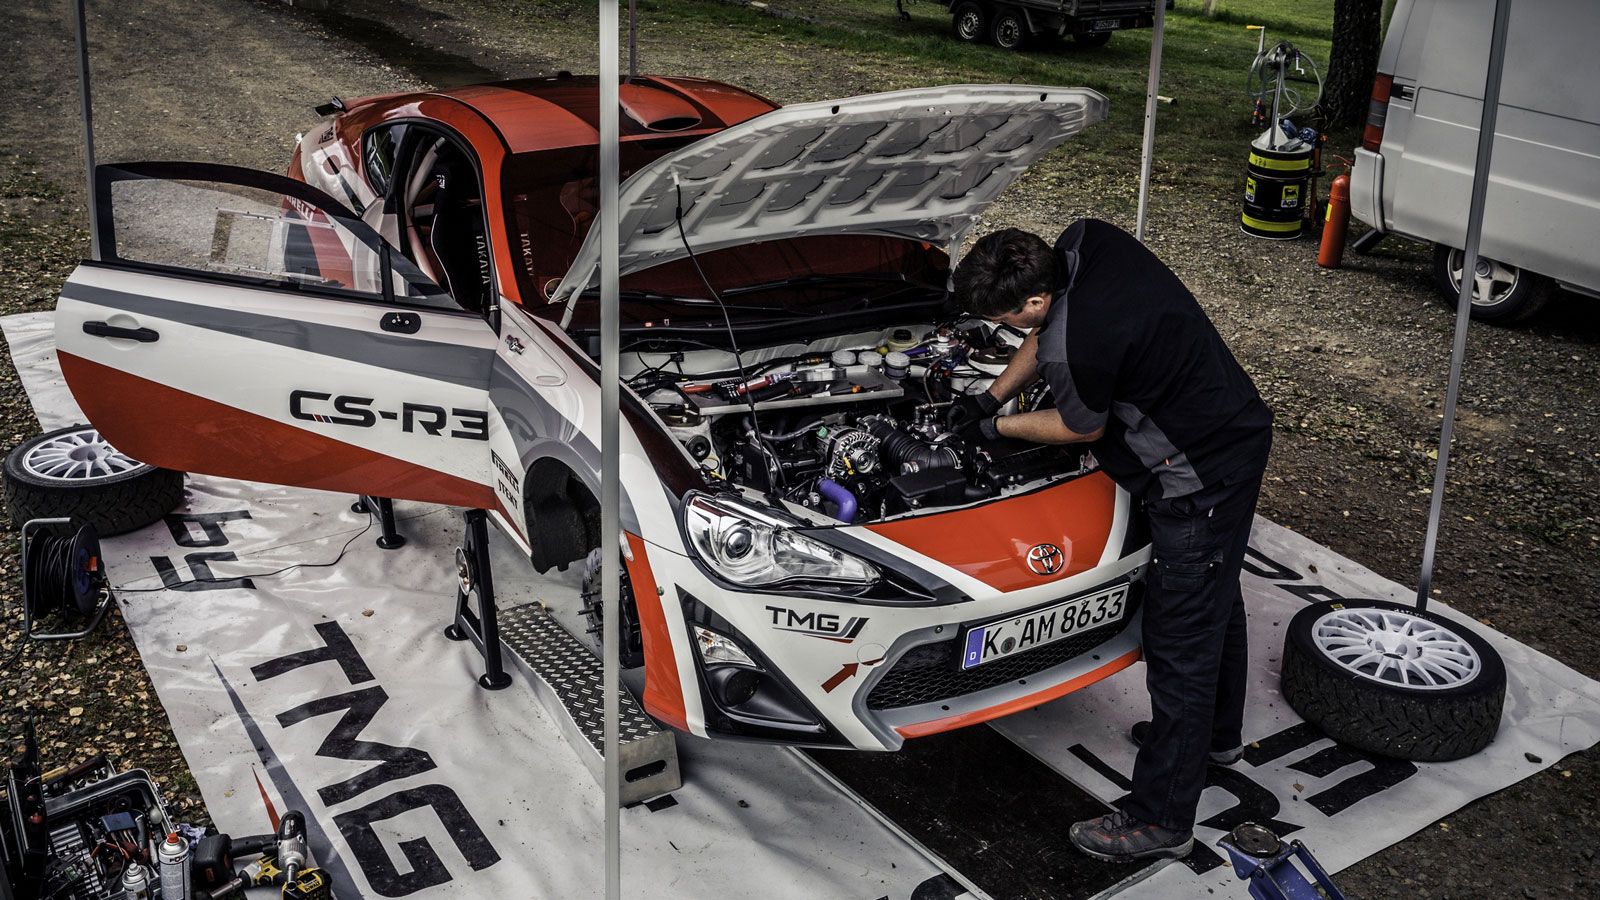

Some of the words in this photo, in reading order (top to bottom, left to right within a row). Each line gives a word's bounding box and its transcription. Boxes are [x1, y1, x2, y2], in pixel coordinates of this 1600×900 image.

[475, 234, 491, 285] TAKATA
[289, 389, 489, 441] CS-R3
[490, 448, 520, 494] PIRELLI
[765, 605, 840, 632] TMG
[982, 627, 1003, 659] K
[1018, 611, 1057, 648] AM
[1060, 590, 1125, 634] 8633
[969, 651, 977, 661] D
[250, 620, 502, 898] TMG
